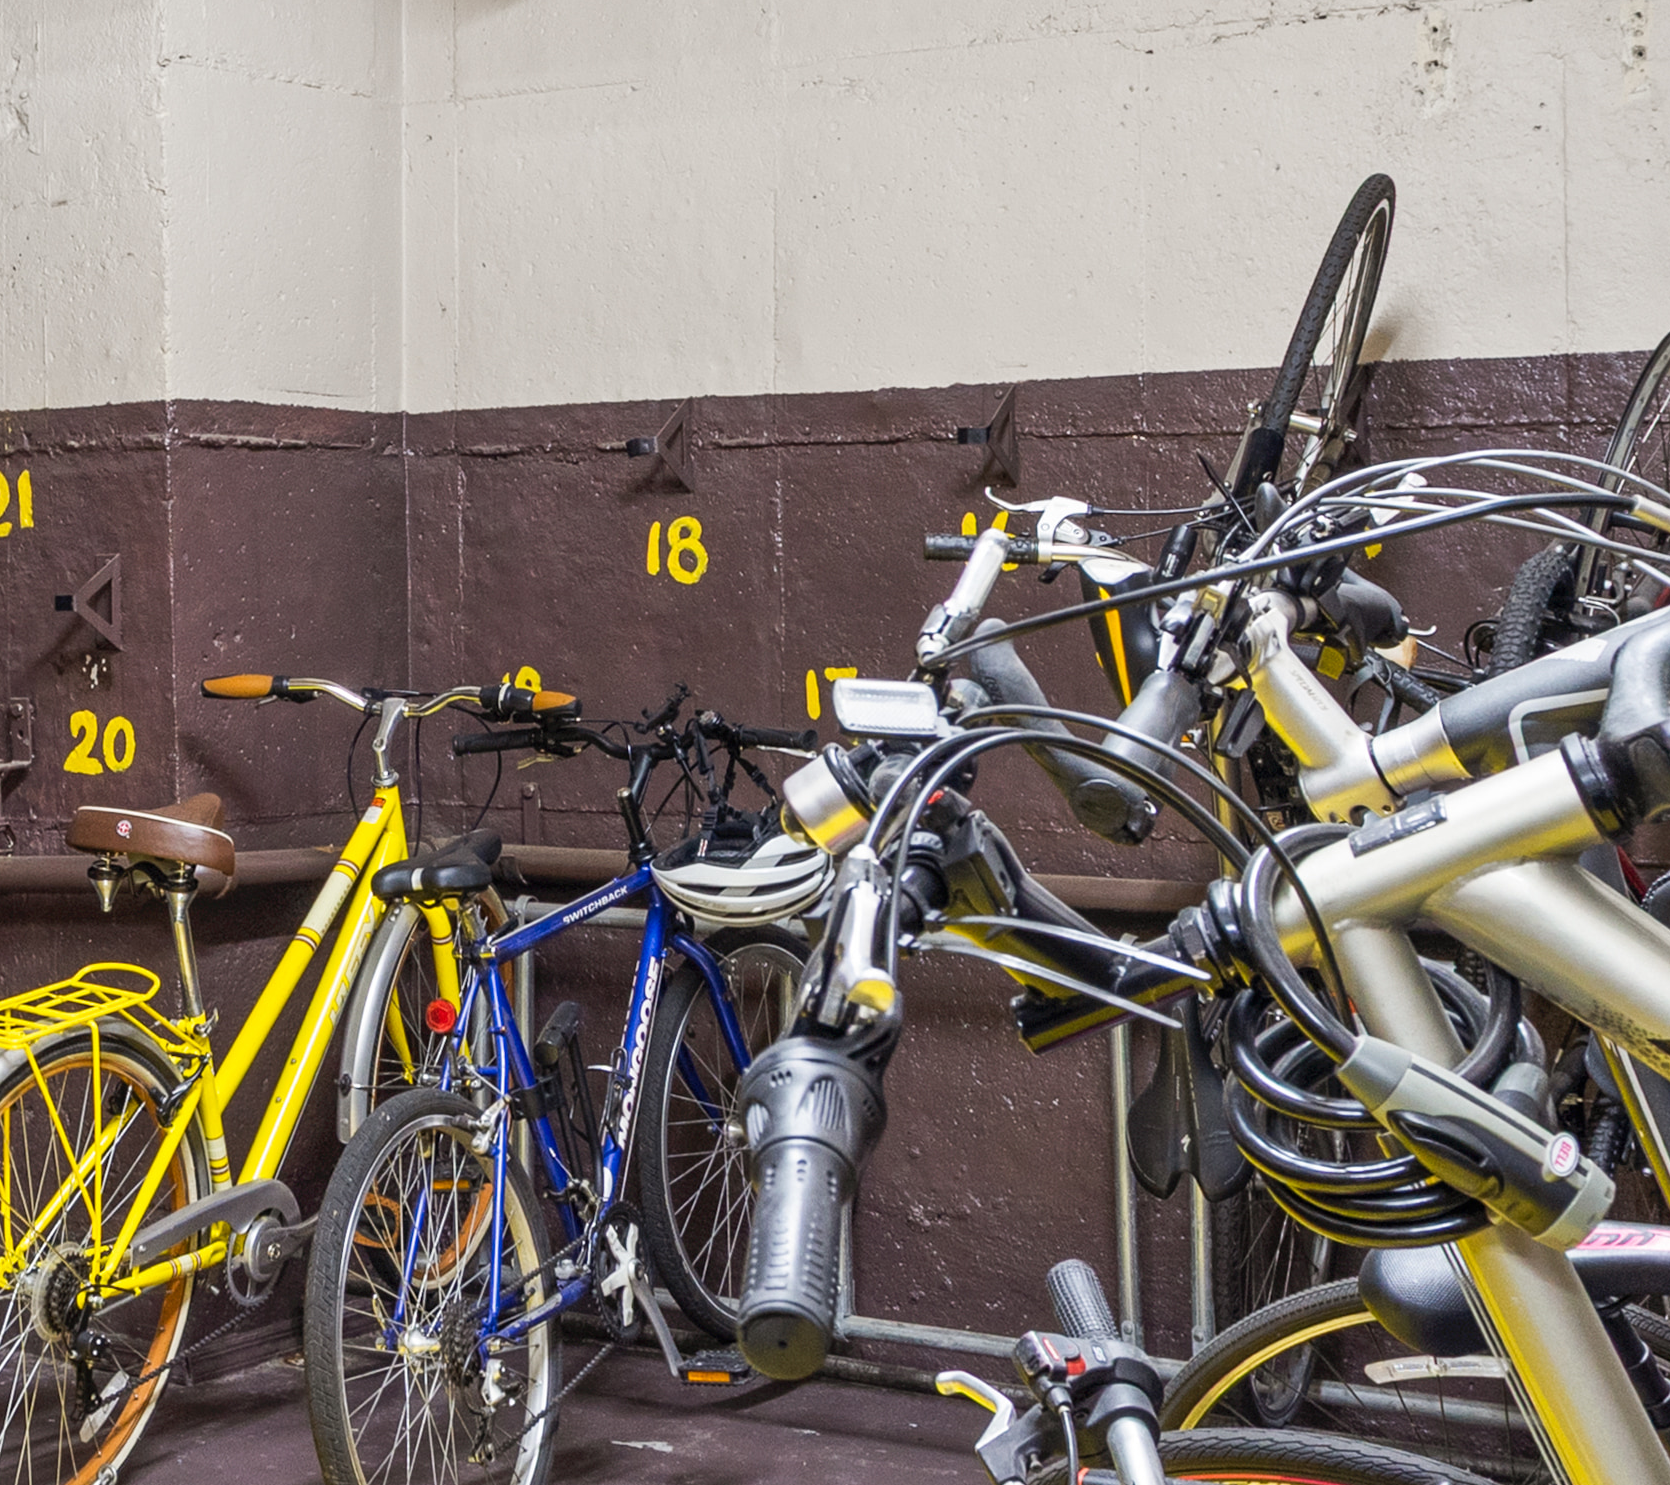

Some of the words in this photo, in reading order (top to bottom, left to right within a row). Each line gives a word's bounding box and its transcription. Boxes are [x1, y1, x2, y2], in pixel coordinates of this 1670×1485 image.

[645, 515, 709, 585] 18
[64, 709, 138, 776] 20
[561, 884, 631, 926] SWITCHBACK
[1552, 1140, 1574, 1169] BELL
